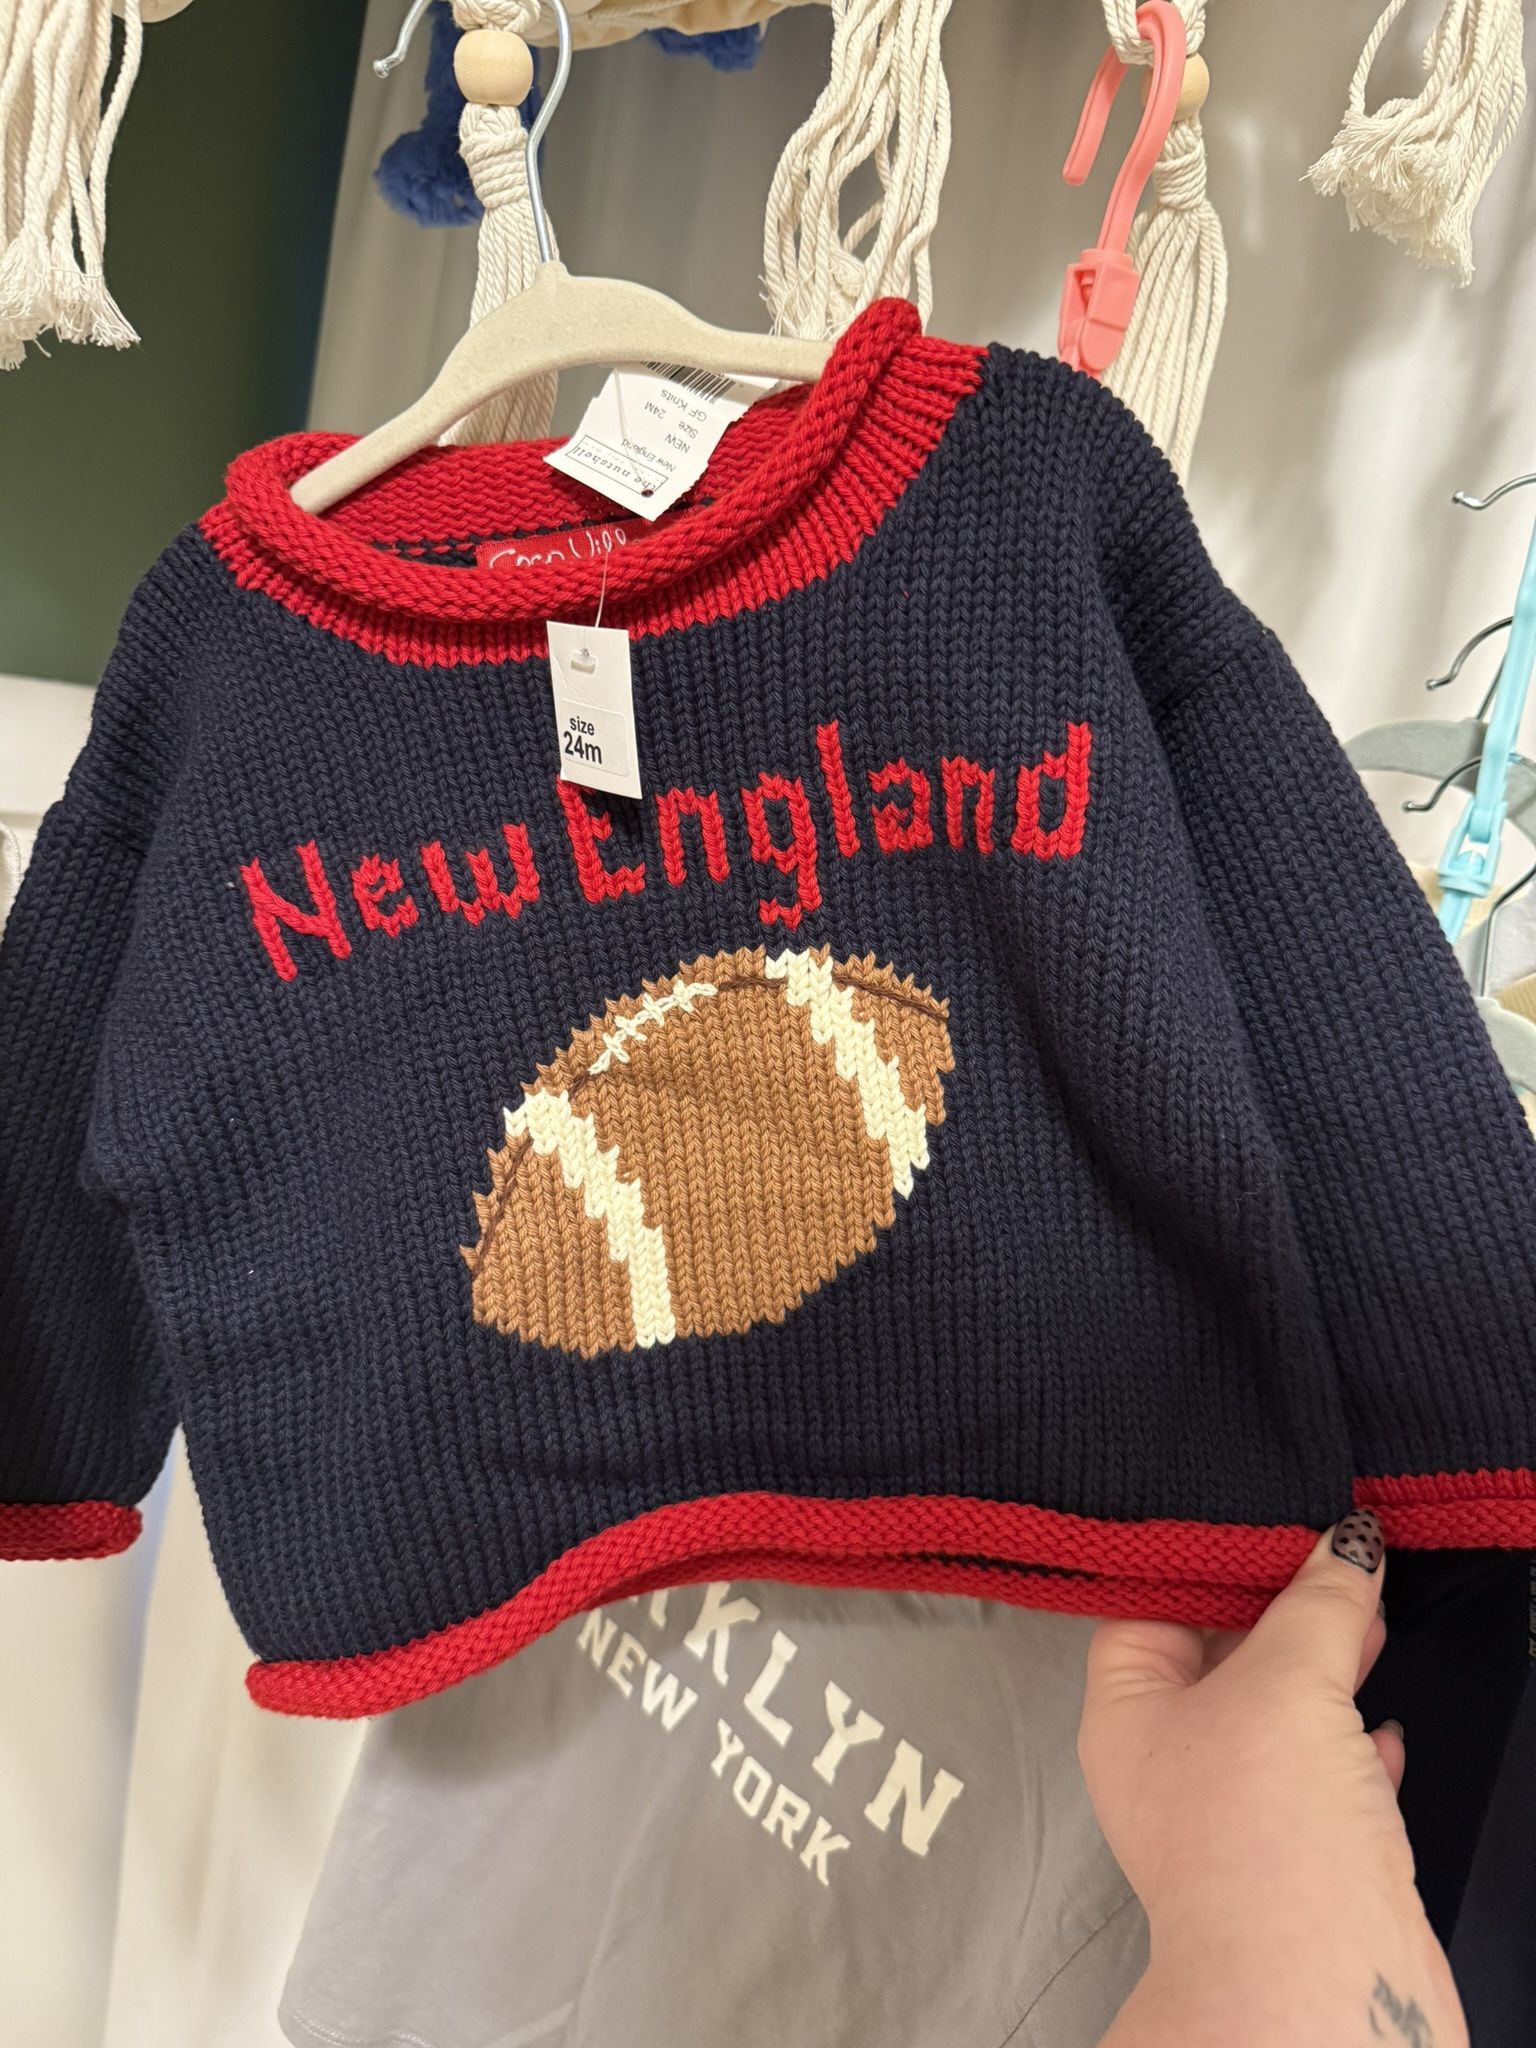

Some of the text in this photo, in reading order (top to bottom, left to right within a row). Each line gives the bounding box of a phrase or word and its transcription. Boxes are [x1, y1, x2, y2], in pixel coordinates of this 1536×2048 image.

[644, 400, 699, 439] Size 24M
[660, 388, 707, 423] GF Knits
[620, 438, 659, 463] England
[664, 433, 691, 454] NEW
[571, 446, 632, 479] nutshell
[655, 453, 677, 473] New
[569, 715, 595, 736] size
[563, 730, 603, 765] 24m
[240, 720, 1093, 983] New England
[577, 1606, 852, 1886] NEW YORK
